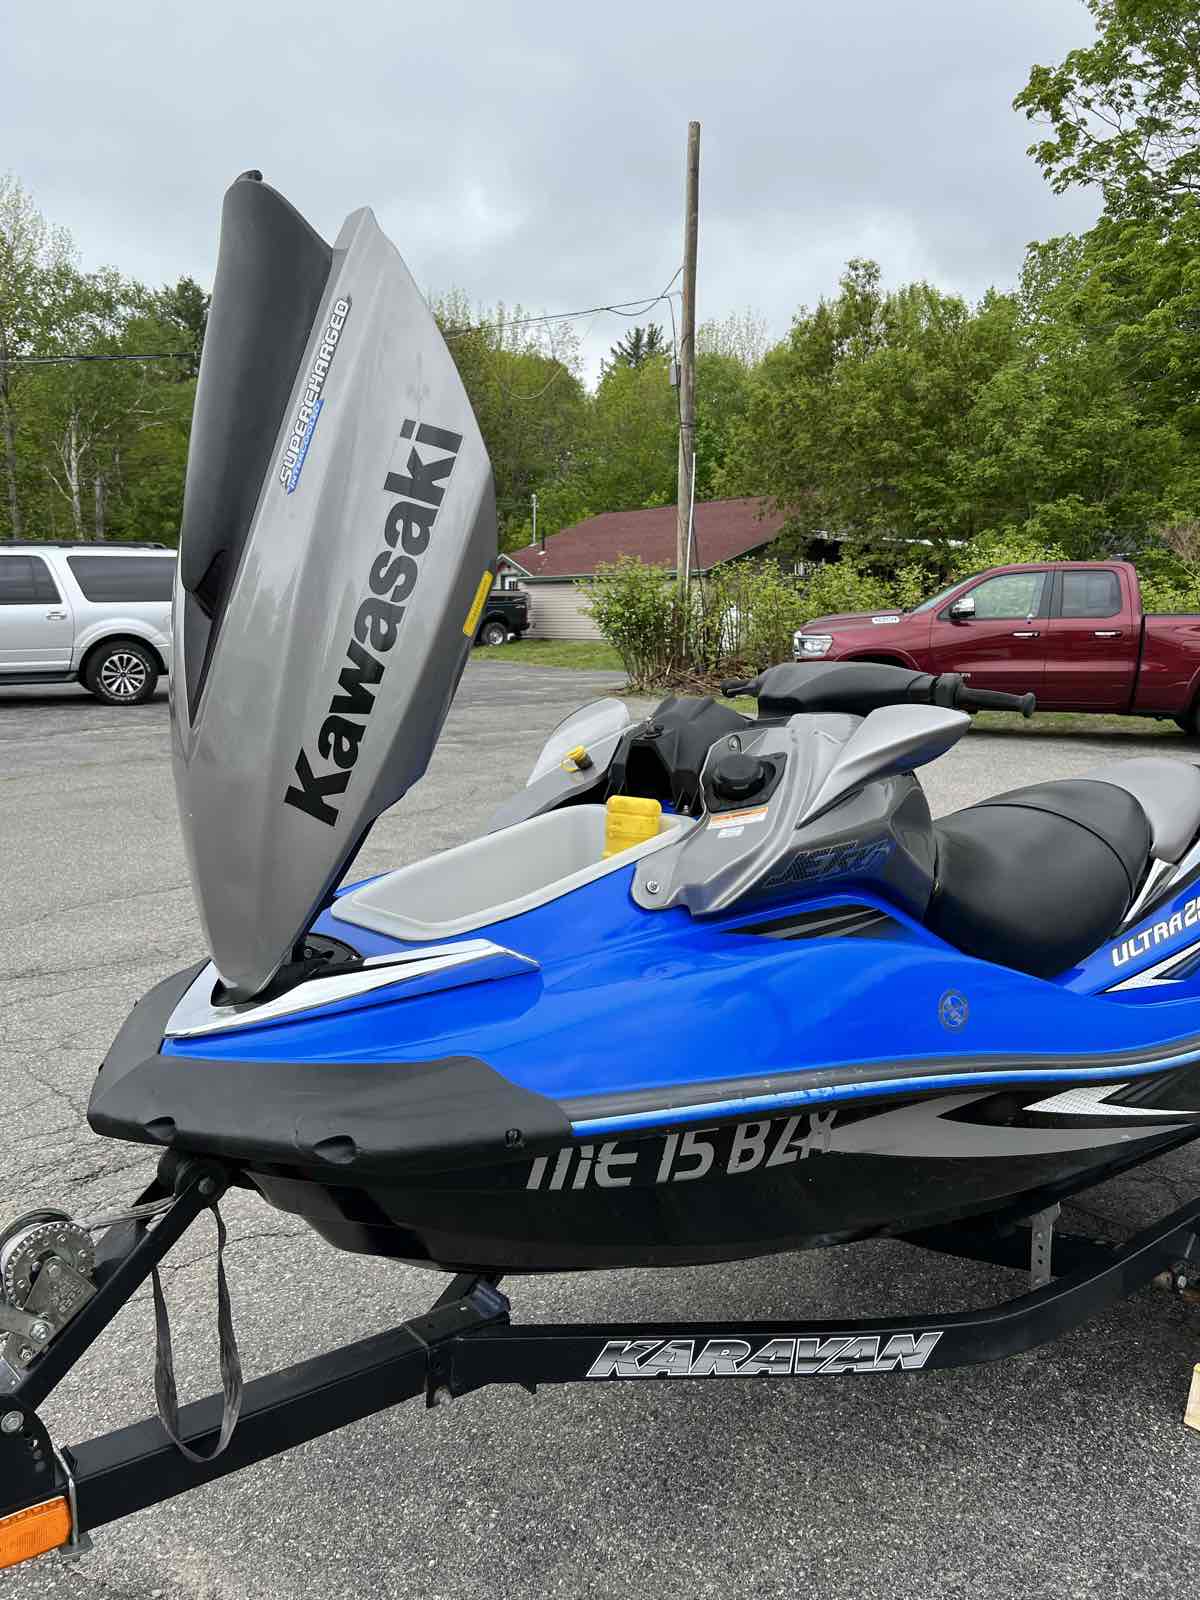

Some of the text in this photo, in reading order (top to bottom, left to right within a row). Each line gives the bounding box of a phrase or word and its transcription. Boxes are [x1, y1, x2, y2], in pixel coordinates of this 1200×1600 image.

[281, 299, 350, 487] SUPERCHARGED
[284, 419, 464, 827] Kawasaki
[655, 1127, 720, 1184] 15
[585, 1331, 944, 1377] KARAVAN
